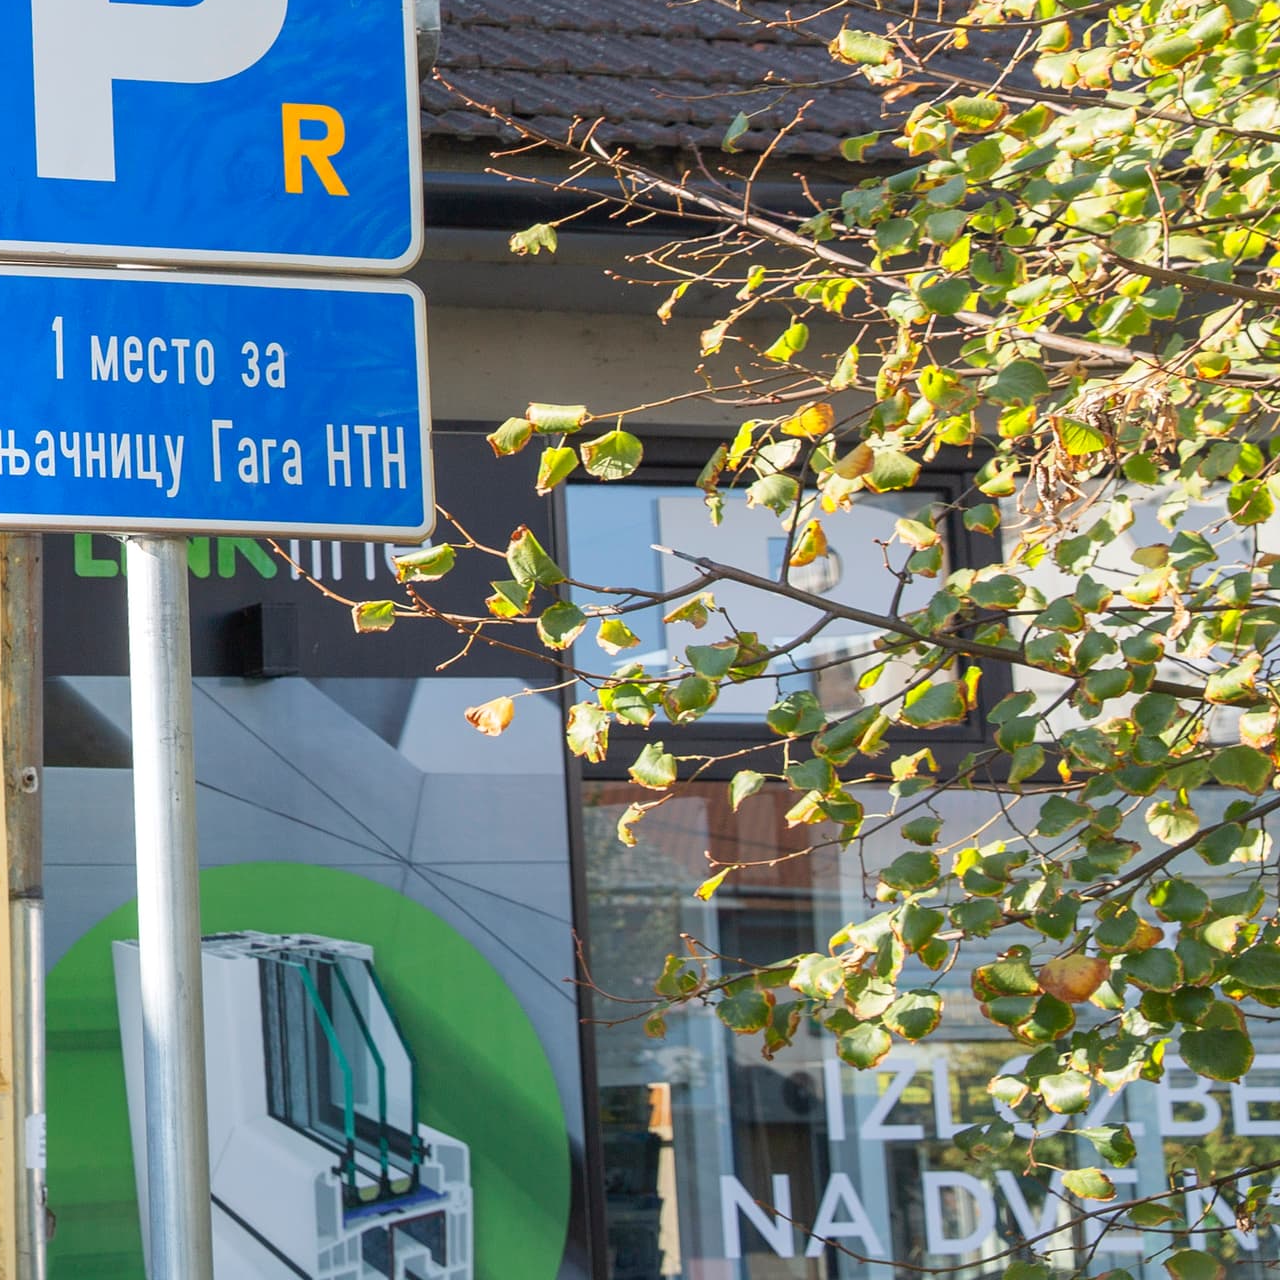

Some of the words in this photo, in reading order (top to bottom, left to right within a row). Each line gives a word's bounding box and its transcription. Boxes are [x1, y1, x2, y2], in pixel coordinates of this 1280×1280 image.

[281, 102, 350, 196] R
[51, 315, 65, 380] 1
[90, 334, 216, 386] место
[240, 340, 287, 389] за
[211, 419, 304, 486] Гага
[326, 423, 407, 489] НТН
[719, 1172, 886, 1260] NA
